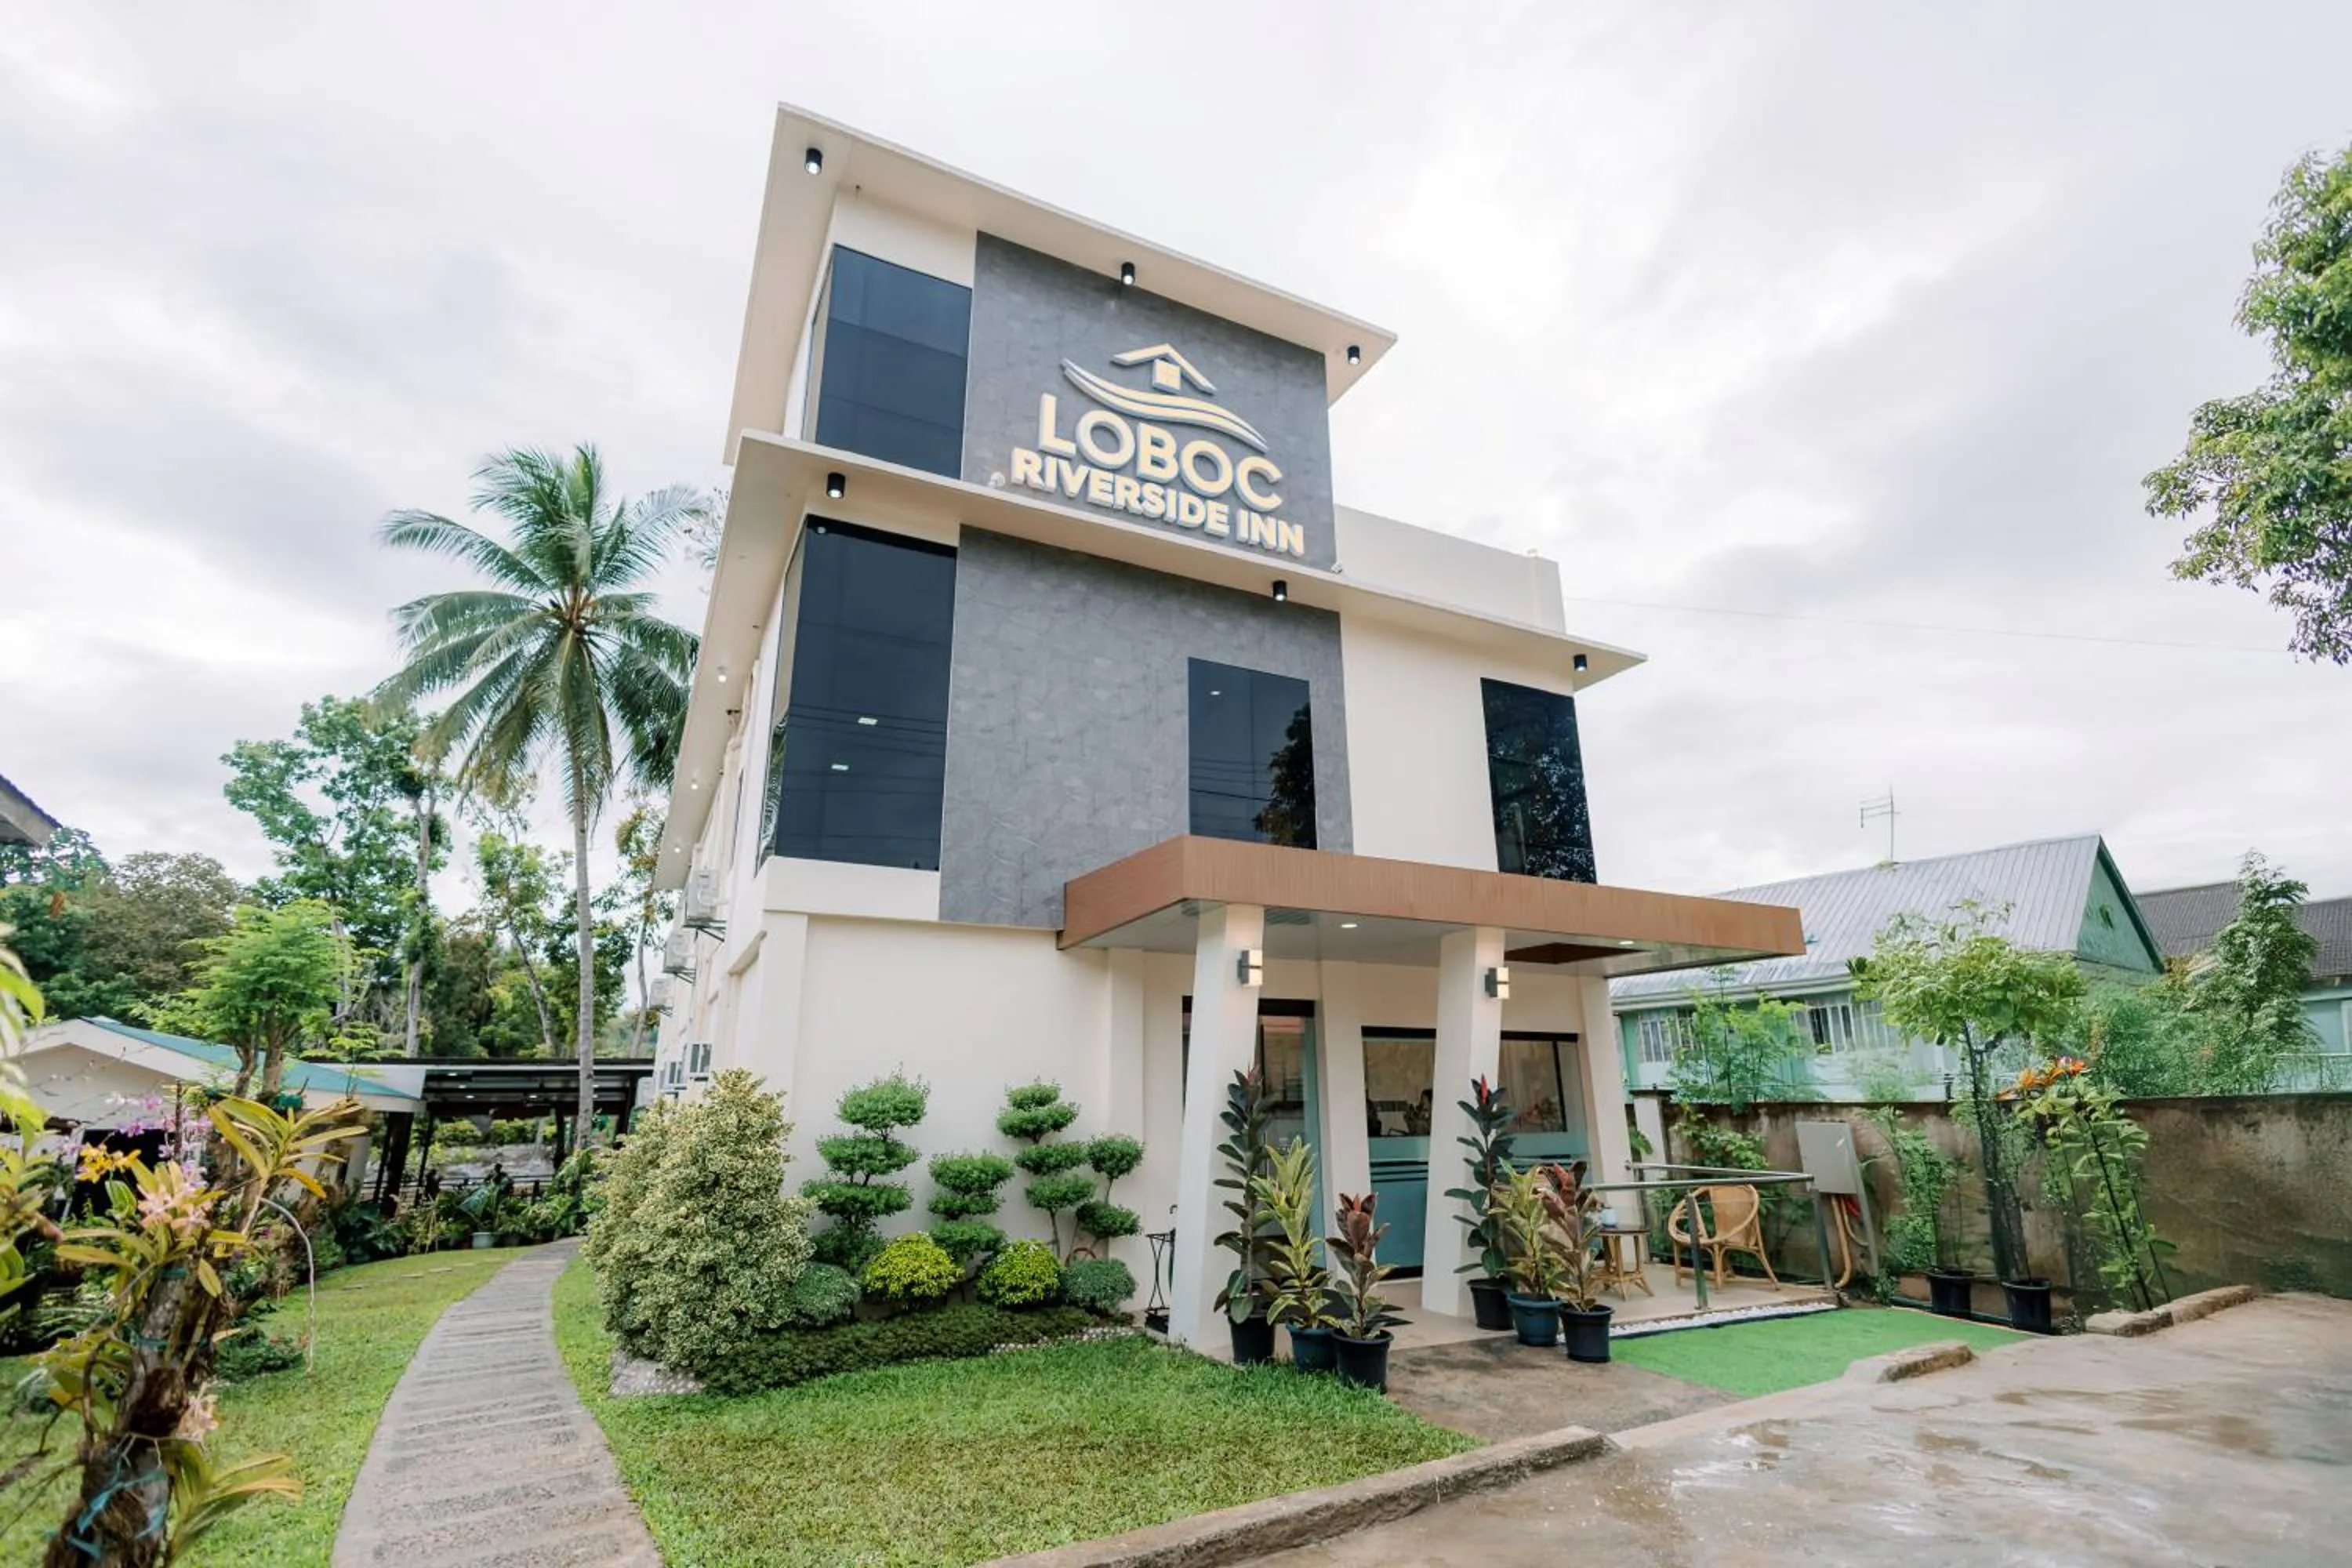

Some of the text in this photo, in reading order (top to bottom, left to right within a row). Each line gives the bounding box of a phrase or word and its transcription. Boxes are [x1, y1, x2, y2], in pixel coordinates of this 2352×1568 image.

[1011, 447, 1305, 556] RIVERSIDE INN
[1039, 393, 1283, 512] LOBOC
